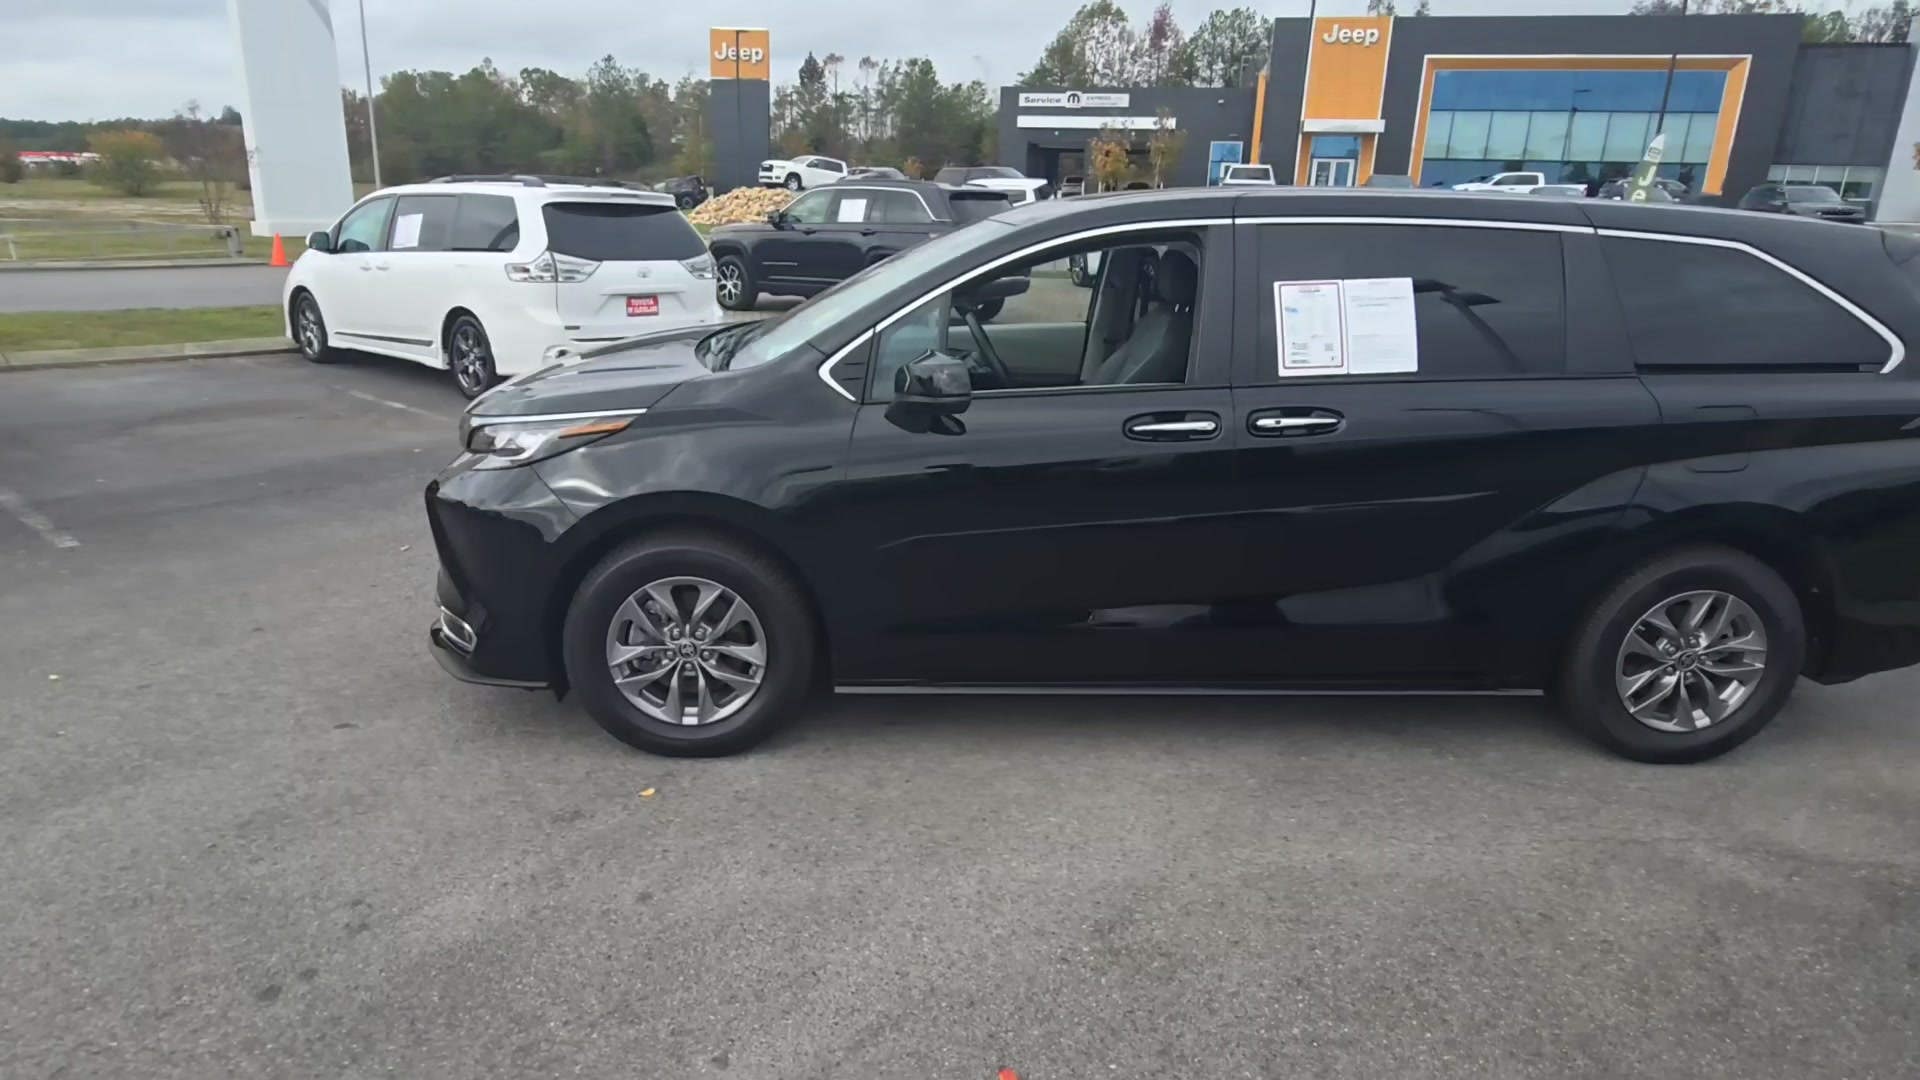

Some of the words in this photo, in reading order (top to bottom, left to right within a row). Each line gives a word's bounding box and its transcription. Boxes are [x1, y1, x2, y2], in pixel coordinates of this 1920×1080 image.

[1323, 24, 1379, 47] Jeep
[714, 42, 763, 63] Jeep
[1024, 96, 1061, 104] Service
